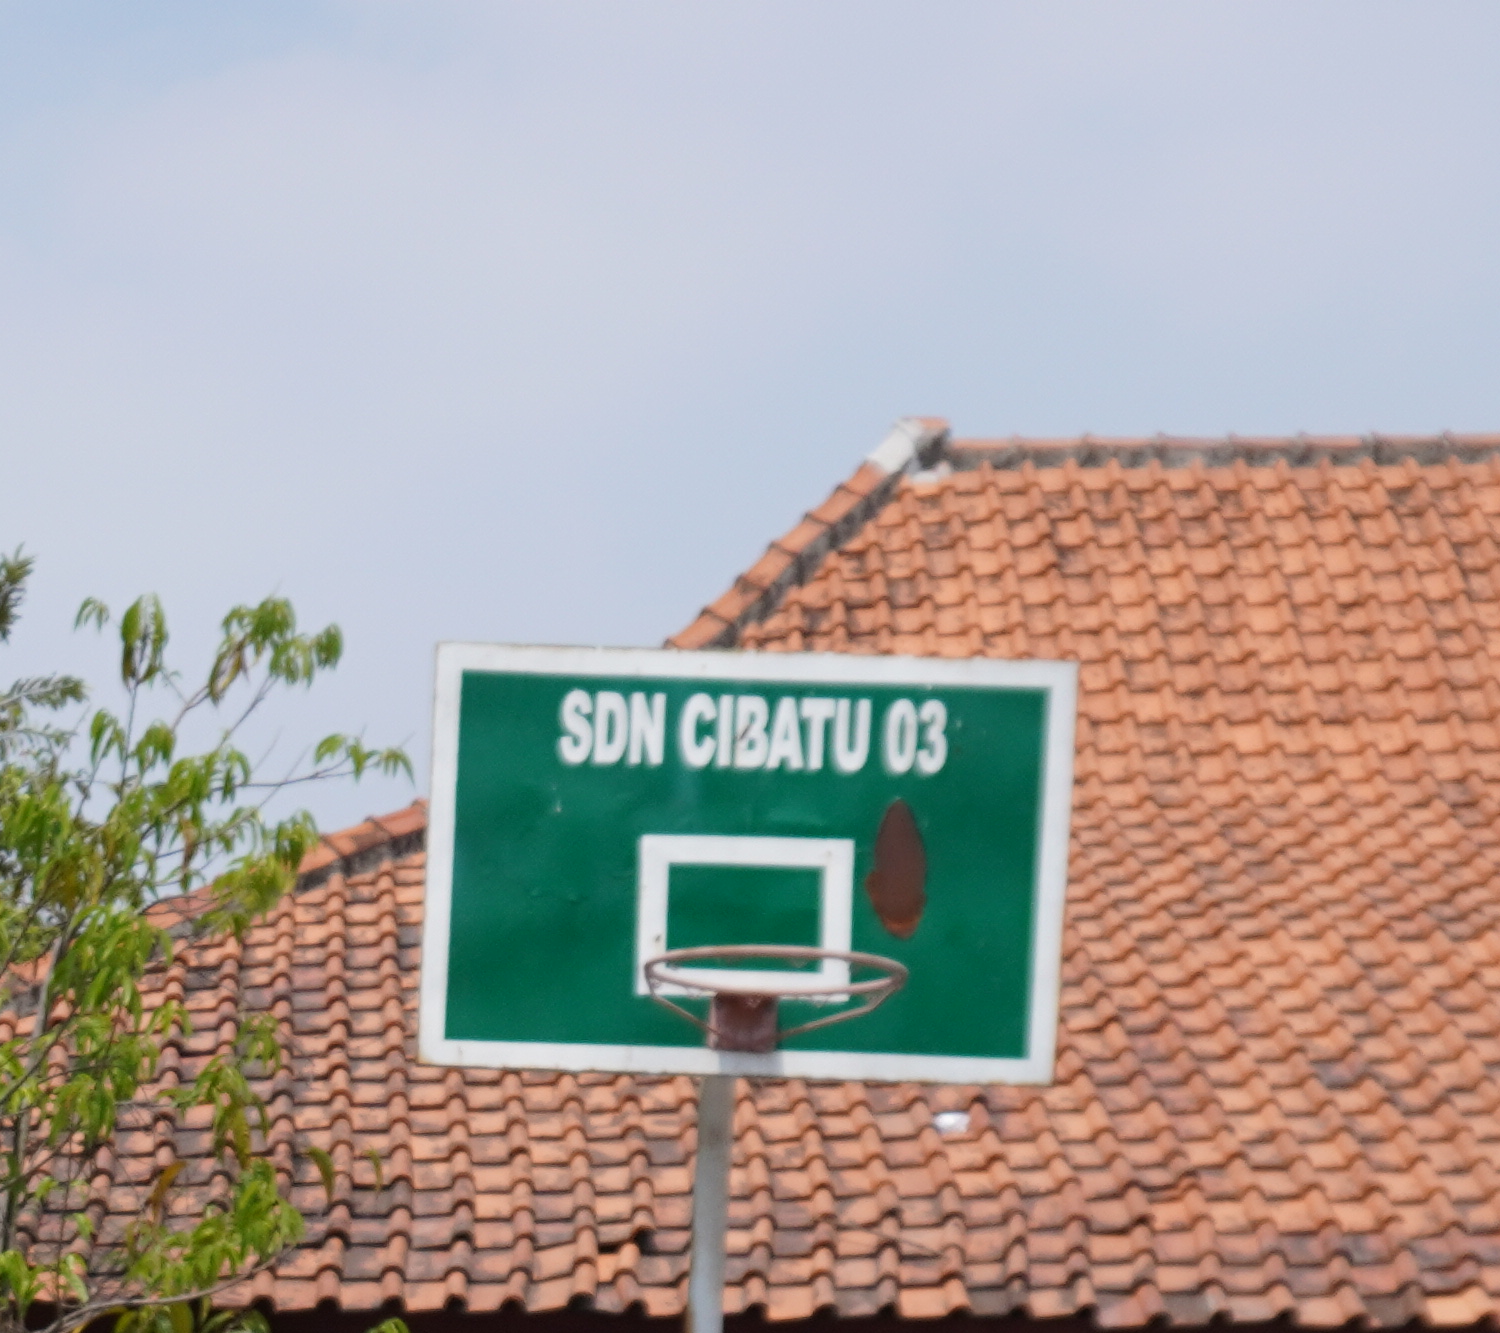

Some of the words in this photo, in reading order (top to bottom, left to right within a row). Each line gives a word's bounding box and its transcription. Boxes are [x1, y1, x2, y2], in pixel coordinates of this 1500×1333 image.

[559, 689, 667, 766] SDN
[681, 692, 872, 773] CIBATU
[885, 697, 949, 775] 03
